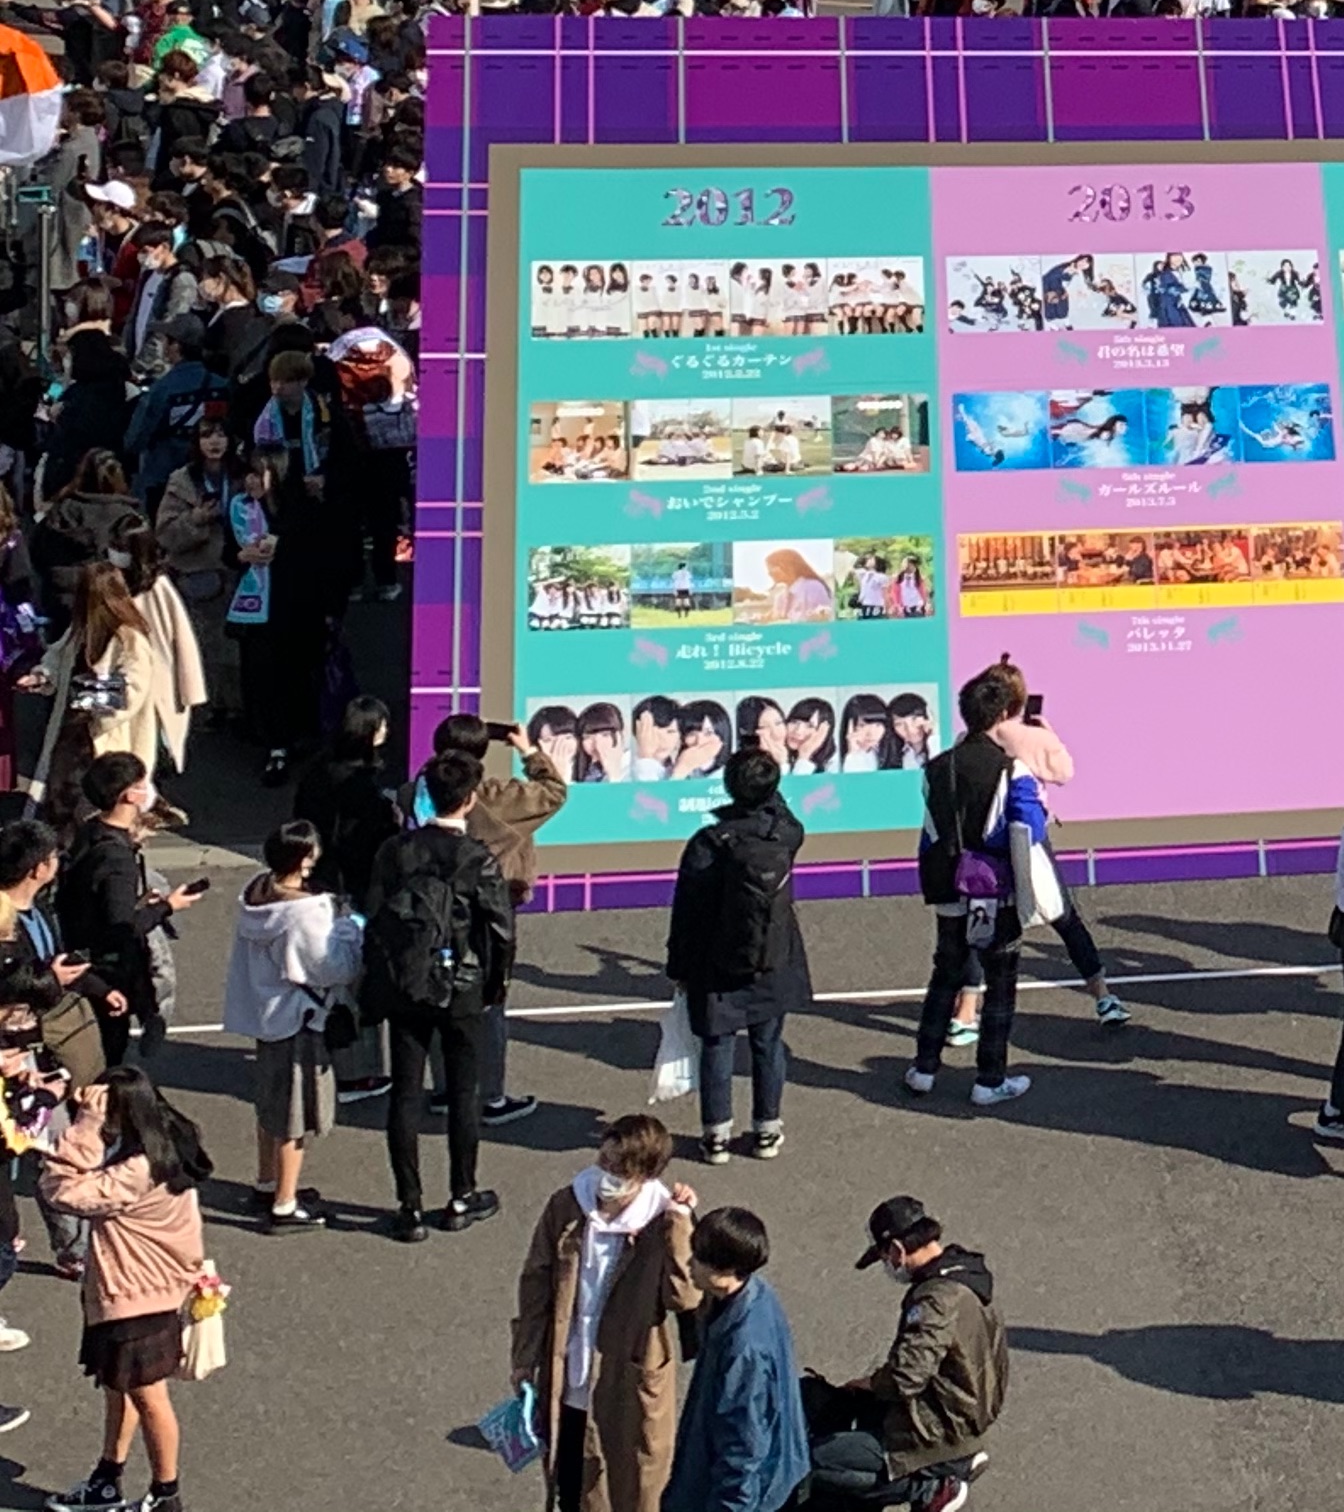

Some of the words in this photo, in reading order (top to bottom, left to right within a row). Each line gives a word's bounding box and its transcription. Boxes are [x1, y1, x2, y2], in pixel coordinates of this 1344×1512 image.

[661, 187, 796, 226] 2012
[1067, 184, 1195, 222] 2013
[1097, 343, 1185, 359] 君の名は希望
[671, 353, 792, 369] ぐるぐるカーテン
[1099, 481, 1201, 496] ガールズルール
[667, 494, 792, 510] おいでシャンプー
[1127, 626, 1186, 639] バレッタ
[728, 641, 792, 658] Bicycle
